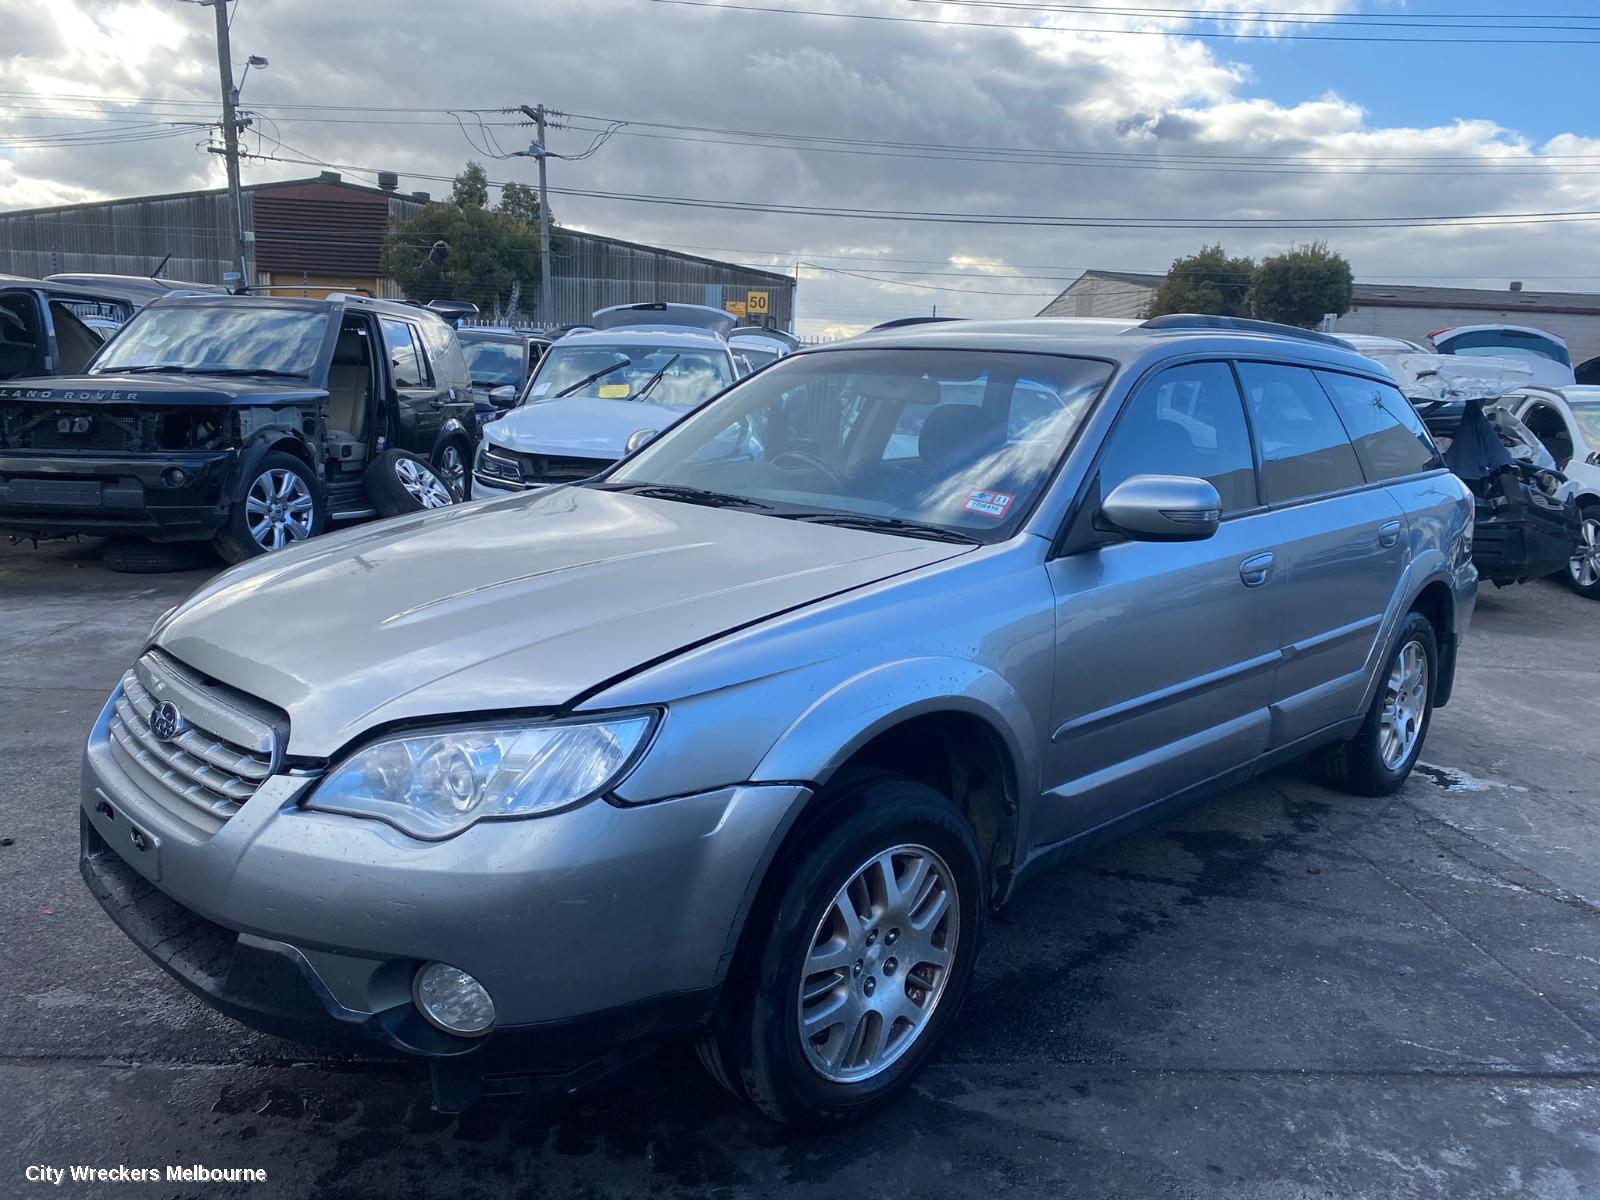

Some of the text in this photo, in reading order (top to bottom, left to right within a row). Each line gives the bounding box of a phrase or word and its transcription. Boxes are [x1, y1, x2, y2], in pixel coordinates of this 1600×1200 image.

[750, 296, 766, 309] 50
[0, 390, 138, 400] LAND ROVER
